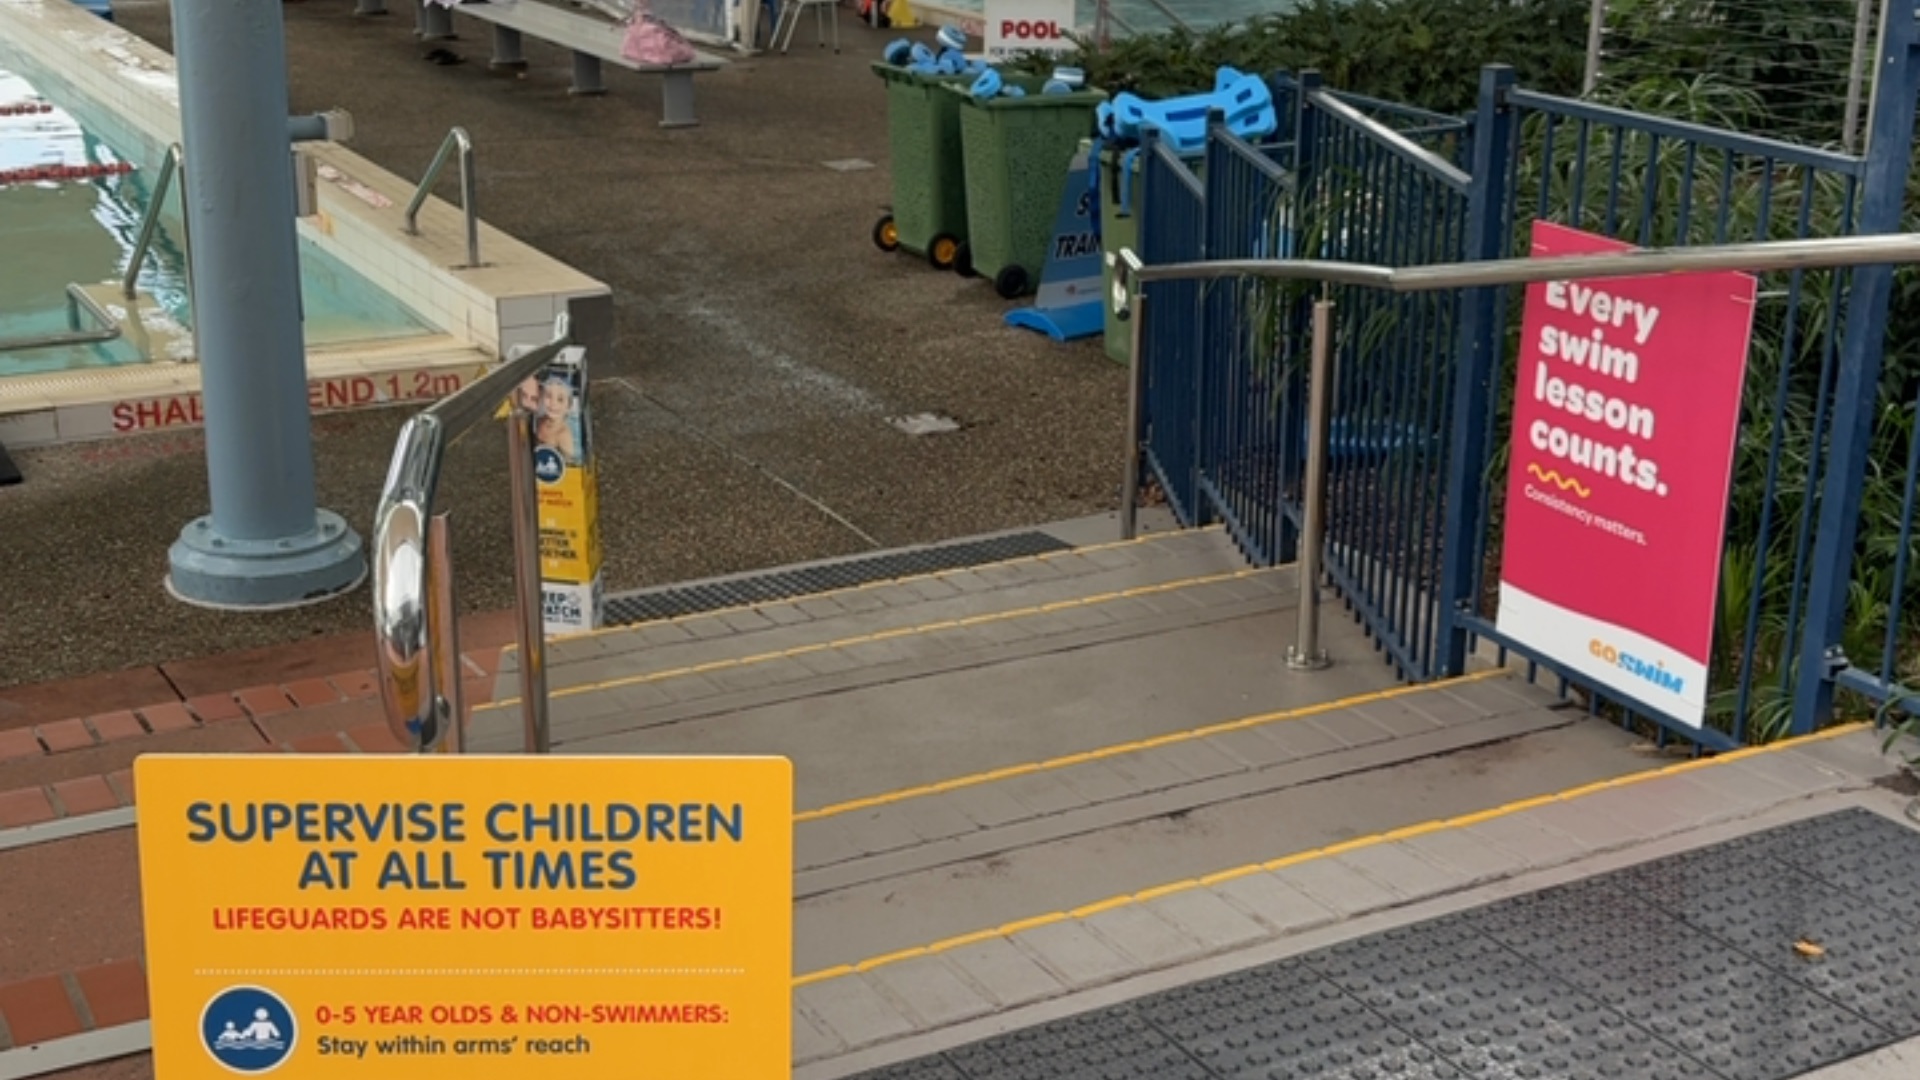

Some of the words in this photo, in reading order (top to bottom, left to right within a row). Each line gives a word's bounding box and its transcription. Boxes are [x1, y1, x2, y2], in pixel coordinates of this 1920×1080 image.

[1001, 20, 1061, 39] POOL
[1545, 281, 1660, 345] Every
[1538, 323, 1639, 384] swim
[112, 396, 205, 432] SHAL
[308, 378, 376, 408] END
[386, 371, 460, 400] 1.2m
[1534, 360, 1655, 440] lesson
[1529, 419, 1669, 497] counts.
[1524, 483, 1593, 526] Consistency
[1593, 515, 1648, 546] matters.
[186, 802, 466, 843] SUPERVISE
[485, 802, 743, 843] CHILDREN
[297, 849, 359, 891] AT
[376, 849, 467, 891] ALL
[482, 848, 638, 891] TIMES
[213, 907, 388, 930] LIFEGUARDS
[398, 907, 449, 930] ARE
[461, 907, 521, 930] NOT
[532, 907, 722, 930] BABYSITTERS!
[316, 1006, 357, 1024] 0-5
[364, 1006, 423, 1024] YEAR
[430, 1006, 493, 1024] OLDS
[500, 1006, 519, 1023] &
[526, 1005, 729, 1024] NON-SWIMMERS:
[317, 1035, 369, 1059] Stay
[375, 1035, 446, 1055] within
[453, 1035, 518, 1055] arms’
[525, 1035, 591, 1055] reach
